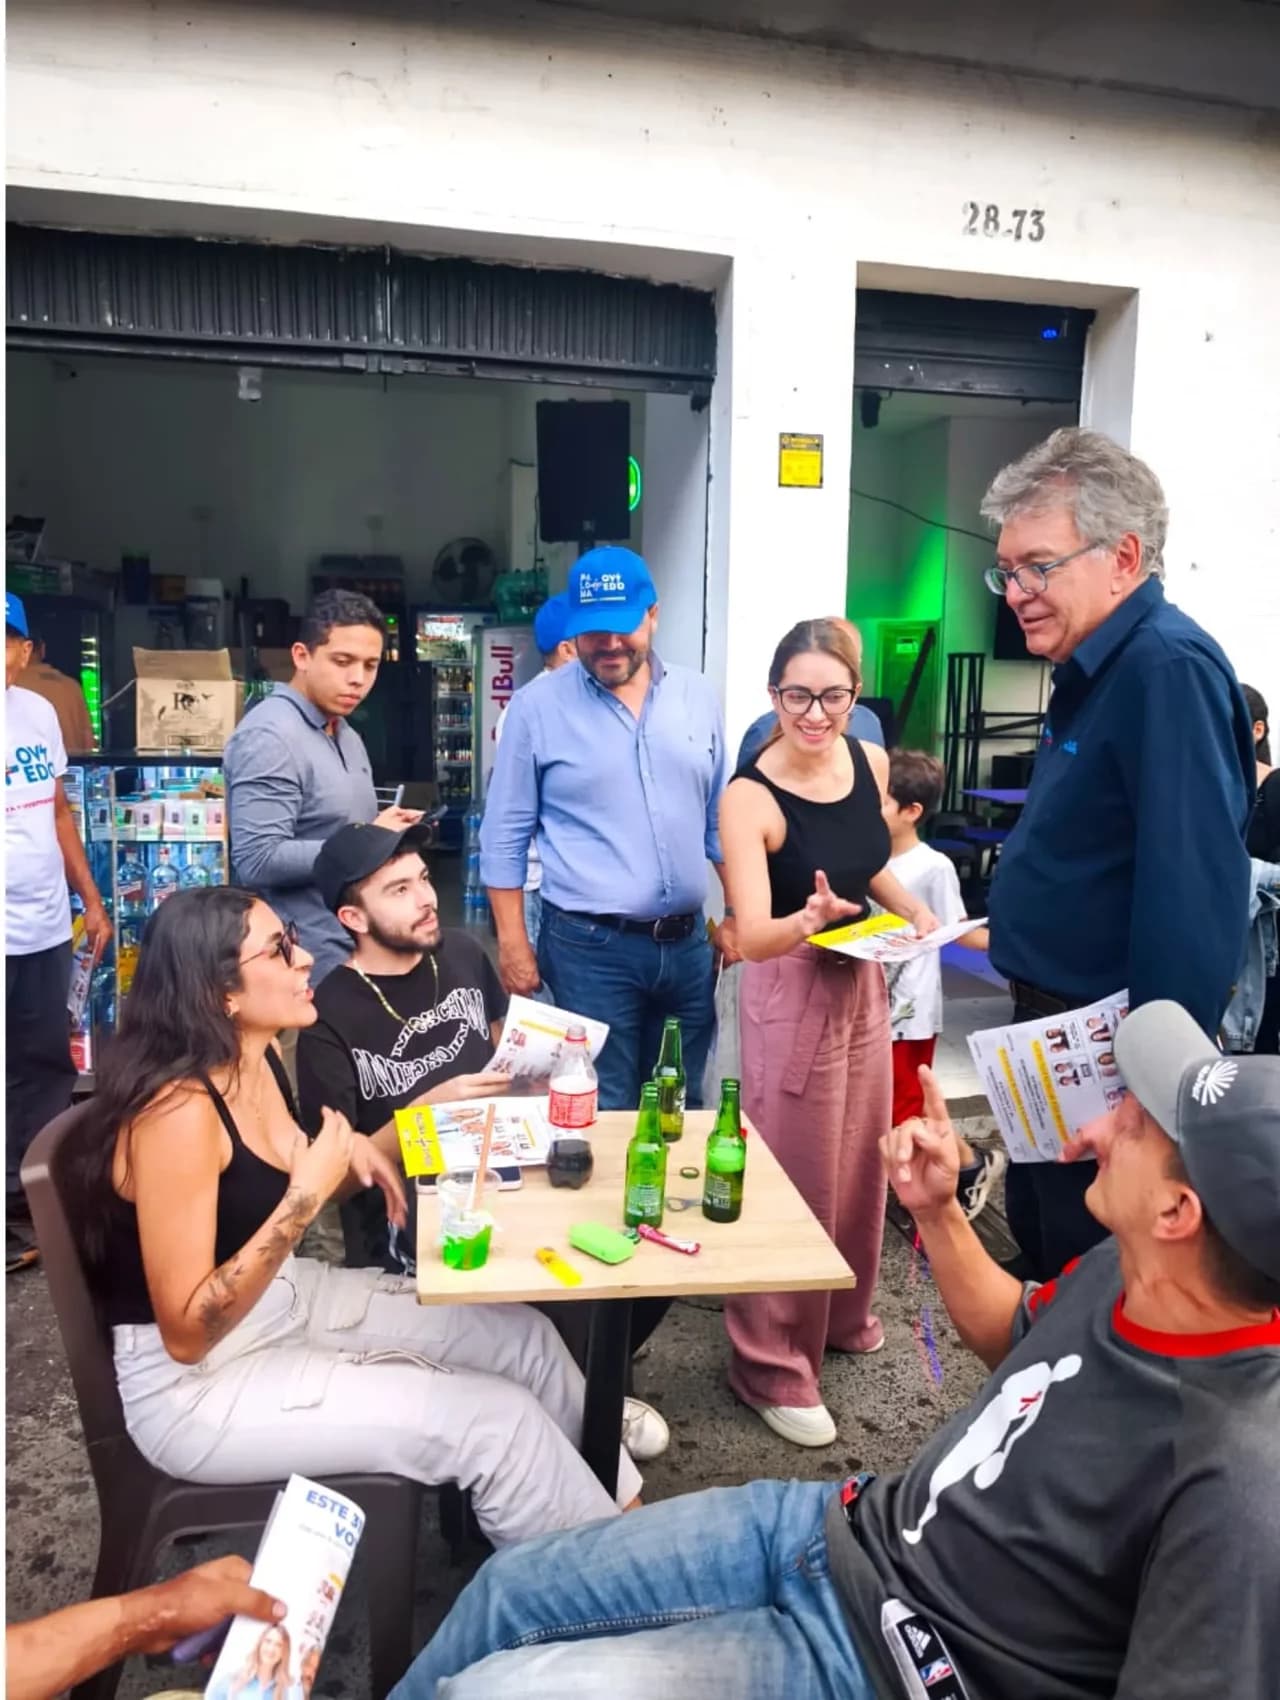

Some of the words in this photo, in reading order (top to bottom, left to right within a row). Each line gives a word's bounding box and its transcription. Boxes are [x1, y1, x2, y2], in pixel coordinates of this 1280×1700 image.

[491, 645, 514, 690] Bull
[305, 1489, 350, 1521] ESTE
[335, 1521, 358, 1547] VO
